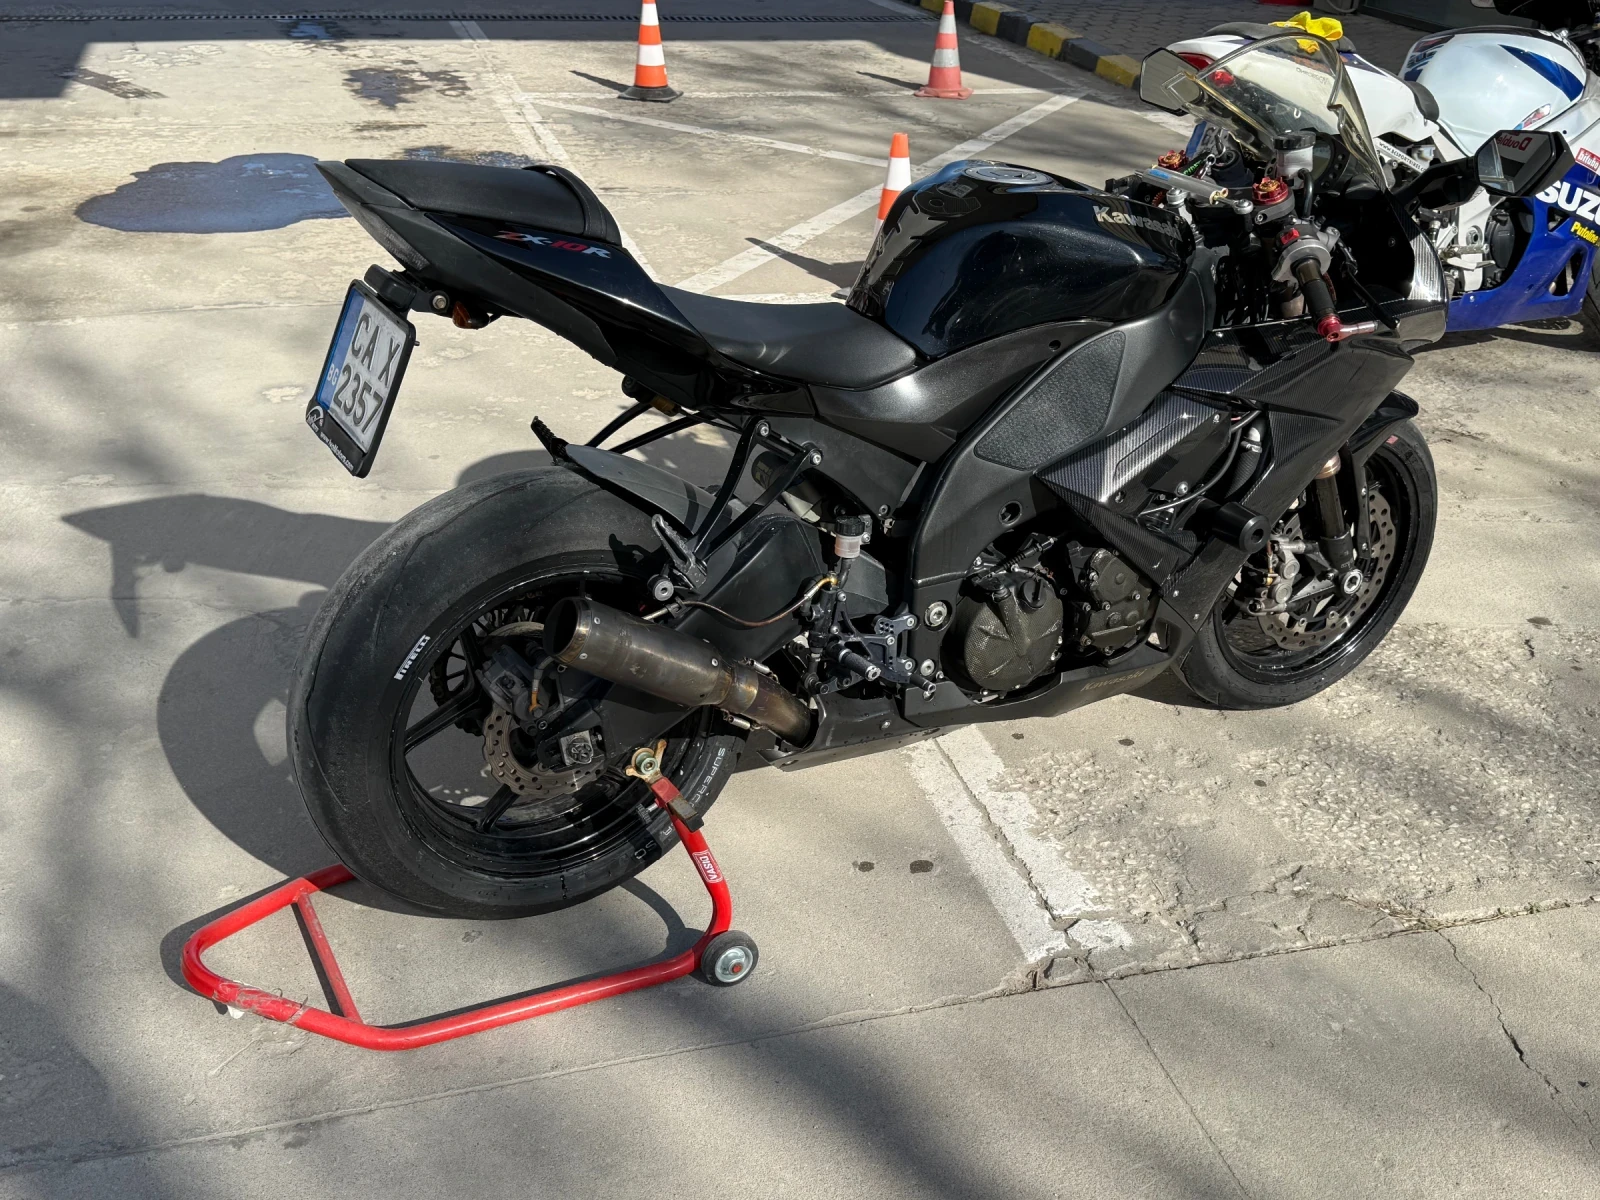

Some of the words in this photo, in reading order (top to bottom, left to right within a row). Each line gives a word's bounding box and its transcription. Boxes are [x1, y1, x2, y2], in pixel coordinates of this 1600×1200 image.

[1093, 205, 1183, 241] Kawasaki
[1535, 180, 1600, 226] SUZ
[493, 230, 611, 259] ZX-10R
[1570, 221, 1599, 245] Putoline
[352, 312, 380, 371] CA
[378, 337, 400, 388] X
[327, 363, 339, 386] BG
[333, 363, 384, 435] 2357
[393, 634, 431, 681] PIRELLI
